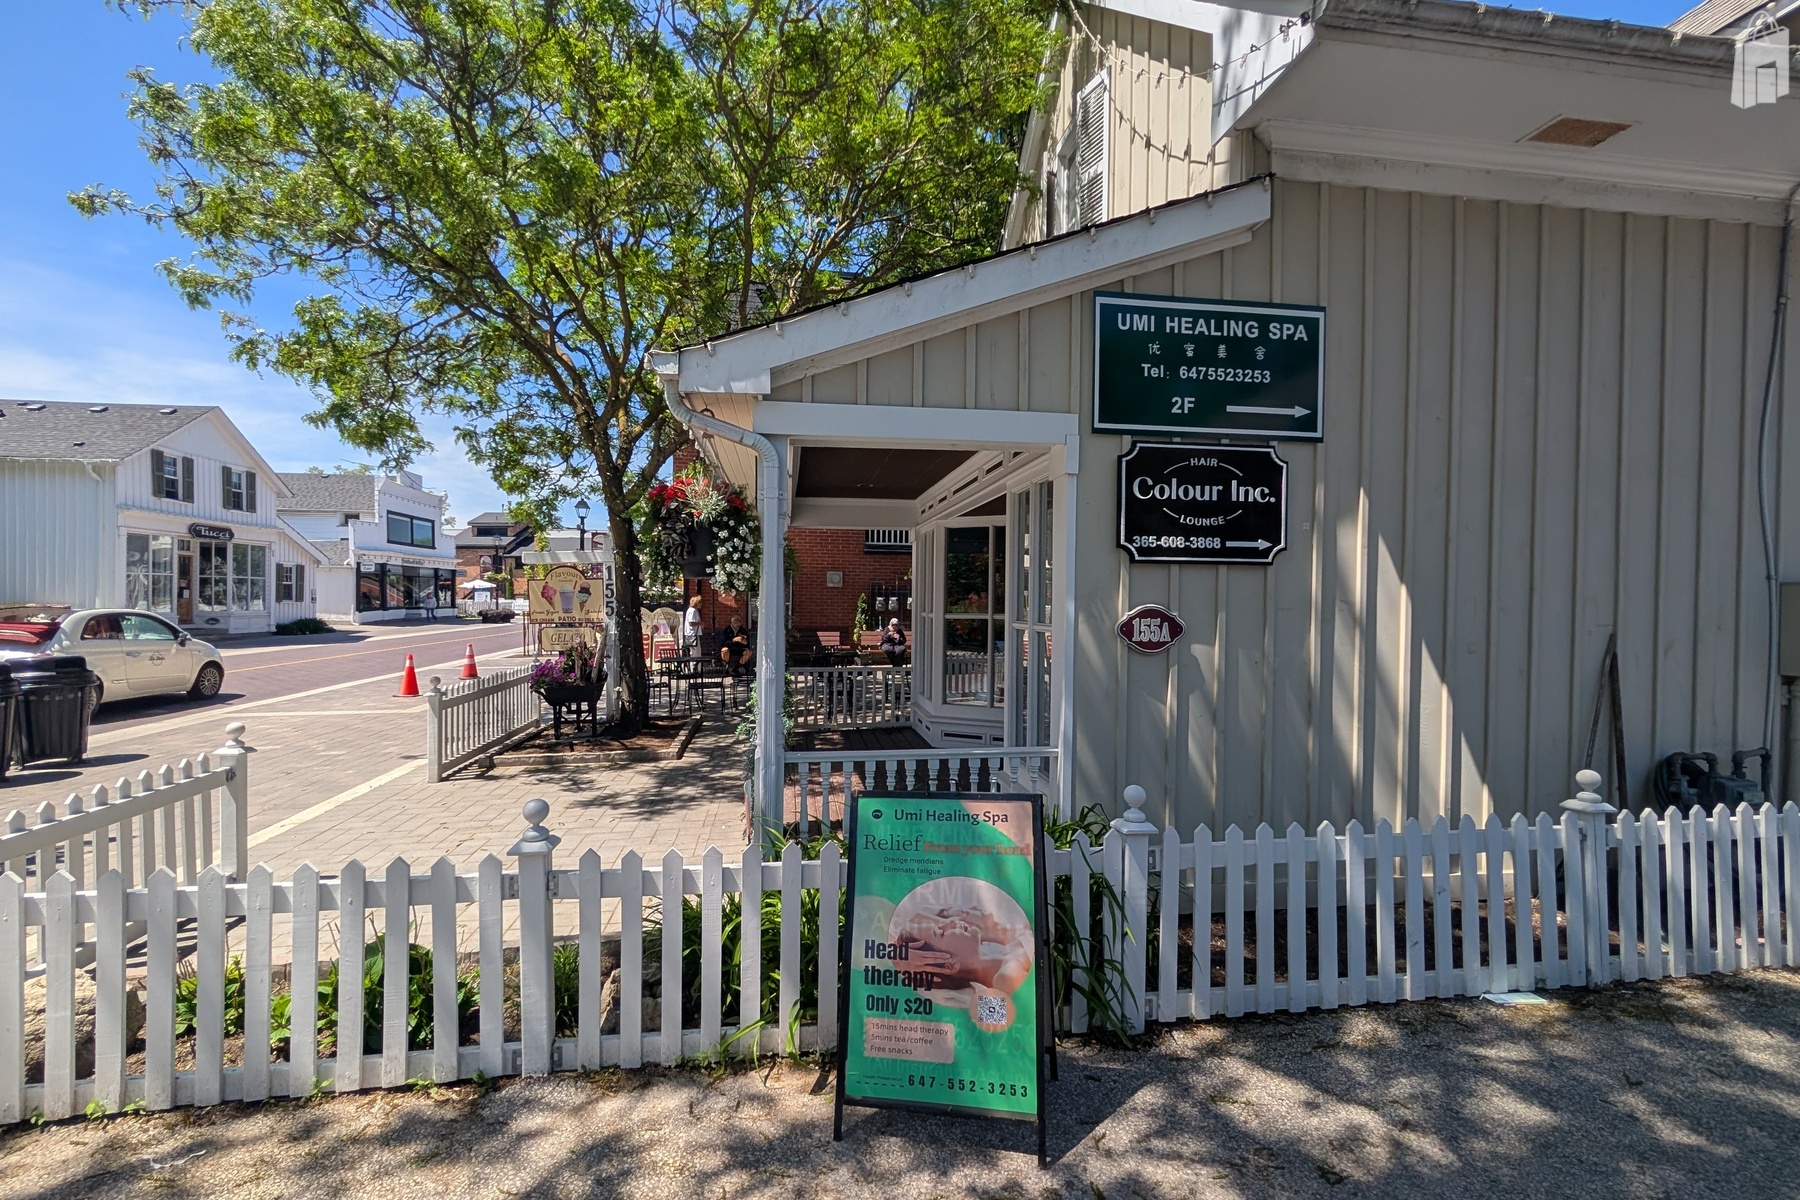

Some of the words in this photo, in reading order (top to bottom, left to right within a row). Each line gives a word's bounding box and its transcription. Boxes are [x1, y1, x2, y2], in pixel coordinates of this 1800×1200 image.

[1117, 313, 1155, 332] UMI
[1165, 316, 1259, 338] HEALING
[1268, 322, 1308, 341] SPA
[1141, 363, 1170, 380] Tel:
[1179, 365, 1271, 384] 6475523253
[1171, 397, 1196, 414] 2F
[1190, 457, 1218, 467] HAIR
[1132, 476, 1223, 501] Colour
[1231, 479, 1276, 503] Inc.
[1180, 514, 1226, 527] LOUNGE
[196, 526, 231, 538] Tucci
[1132, 535, 1221, 549] 365-608-3868
[550, 570, 583, 581] Flavours
[605, 565, 615, 617] 155
[1132, 617, 1171, 642] 155A
[894, 809, 922, 821] Umi
[926, 809, 980, 826] Healing
[983, 811, 1009, 825] Spa
[863, 834, 923, 851] Relief
[883, 856, 908, 864] Dredge
[909, 857, 944, 865] meridians
[883, 866, 916, 874] Eliminate
[916, 867, 941, 875] fatigue
[864, 939, 909, 961] Head
[863, 965, 935, 992] therapy
[866, 994, 899, 1015] Only
[904, 997, 933, 1015] $20
[871, 1022, 897, 1031] 15mins
[899, 1023, 918, 1033] head
[919, 1024, 949, 1036] therapy
[871, 1034, 893, 1043] 5mins
[894, 1034, 934, 1046] tea/coffee
[870, 1045, 887, 1053] Free
[887, 1046, 913, 1055] snacks
